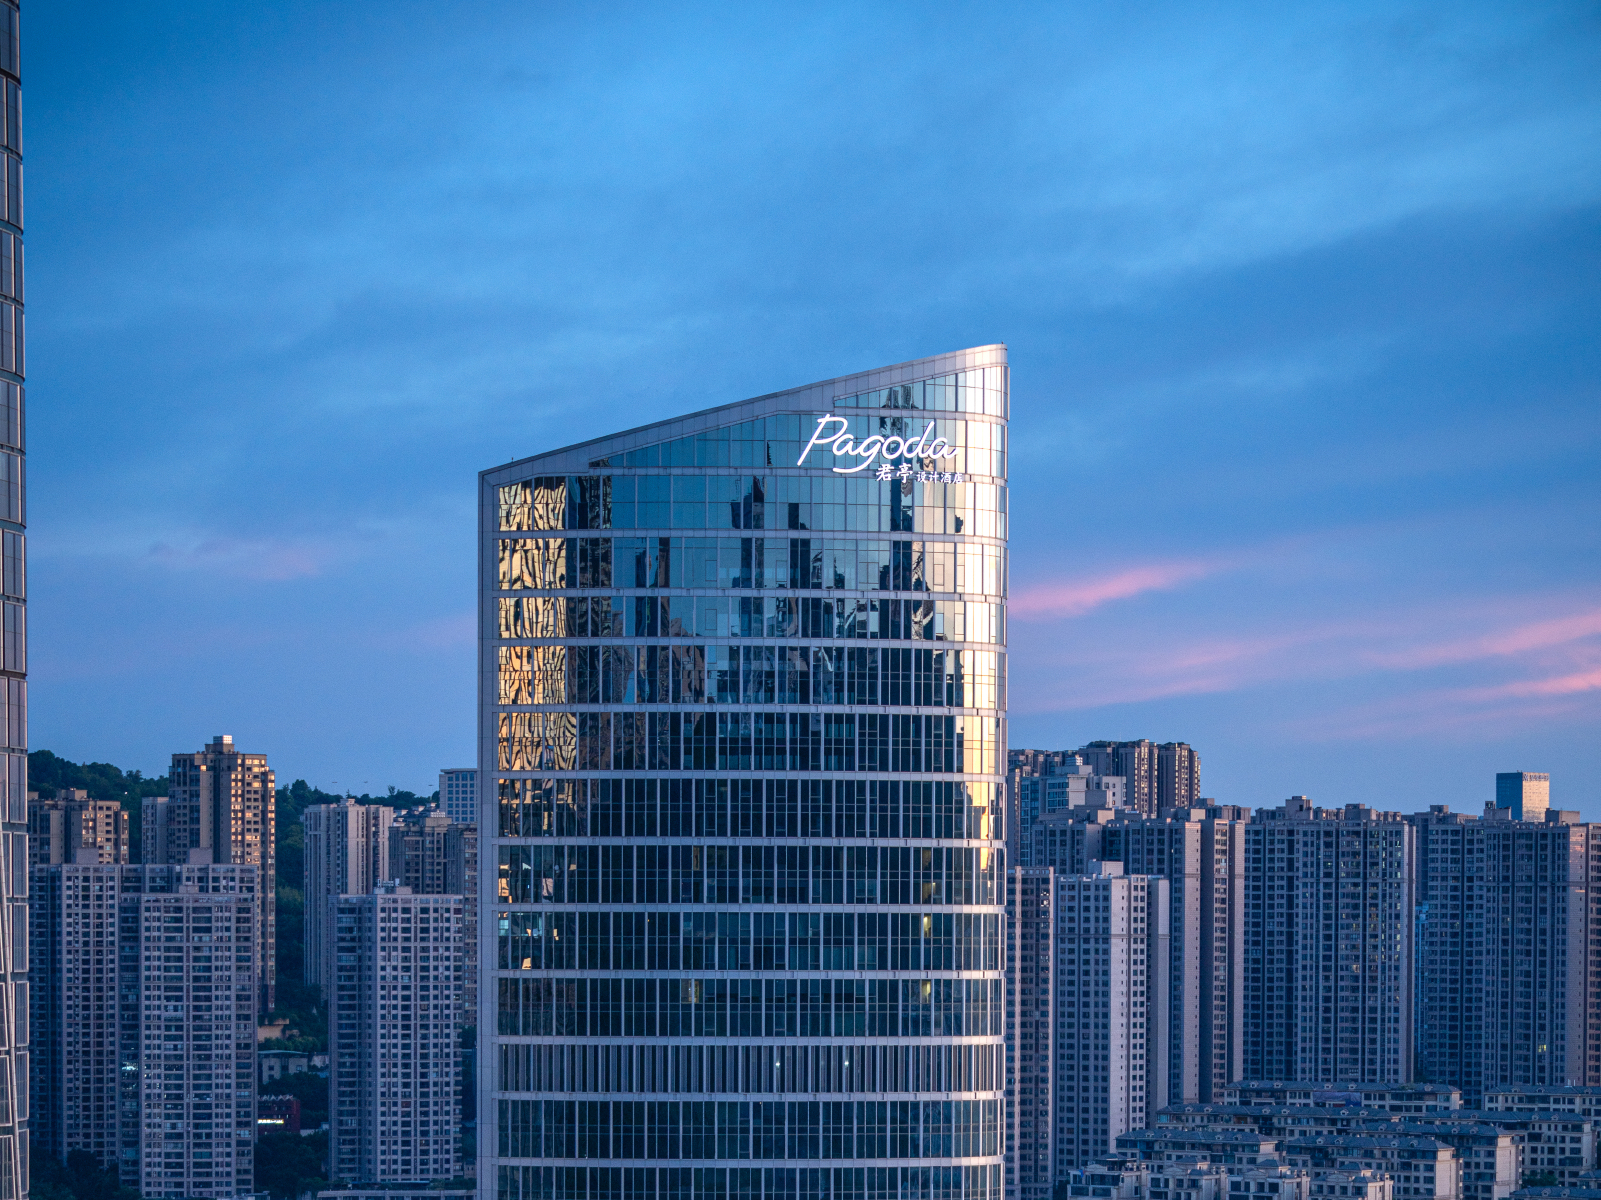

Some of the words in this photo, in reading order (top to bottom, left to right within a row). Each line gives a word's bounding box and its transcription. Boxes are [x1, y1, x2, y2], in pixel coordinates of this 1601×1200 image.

[797, 414, 959, 473] Pagoda
[916, 471, 963, 484] 设计酒店
